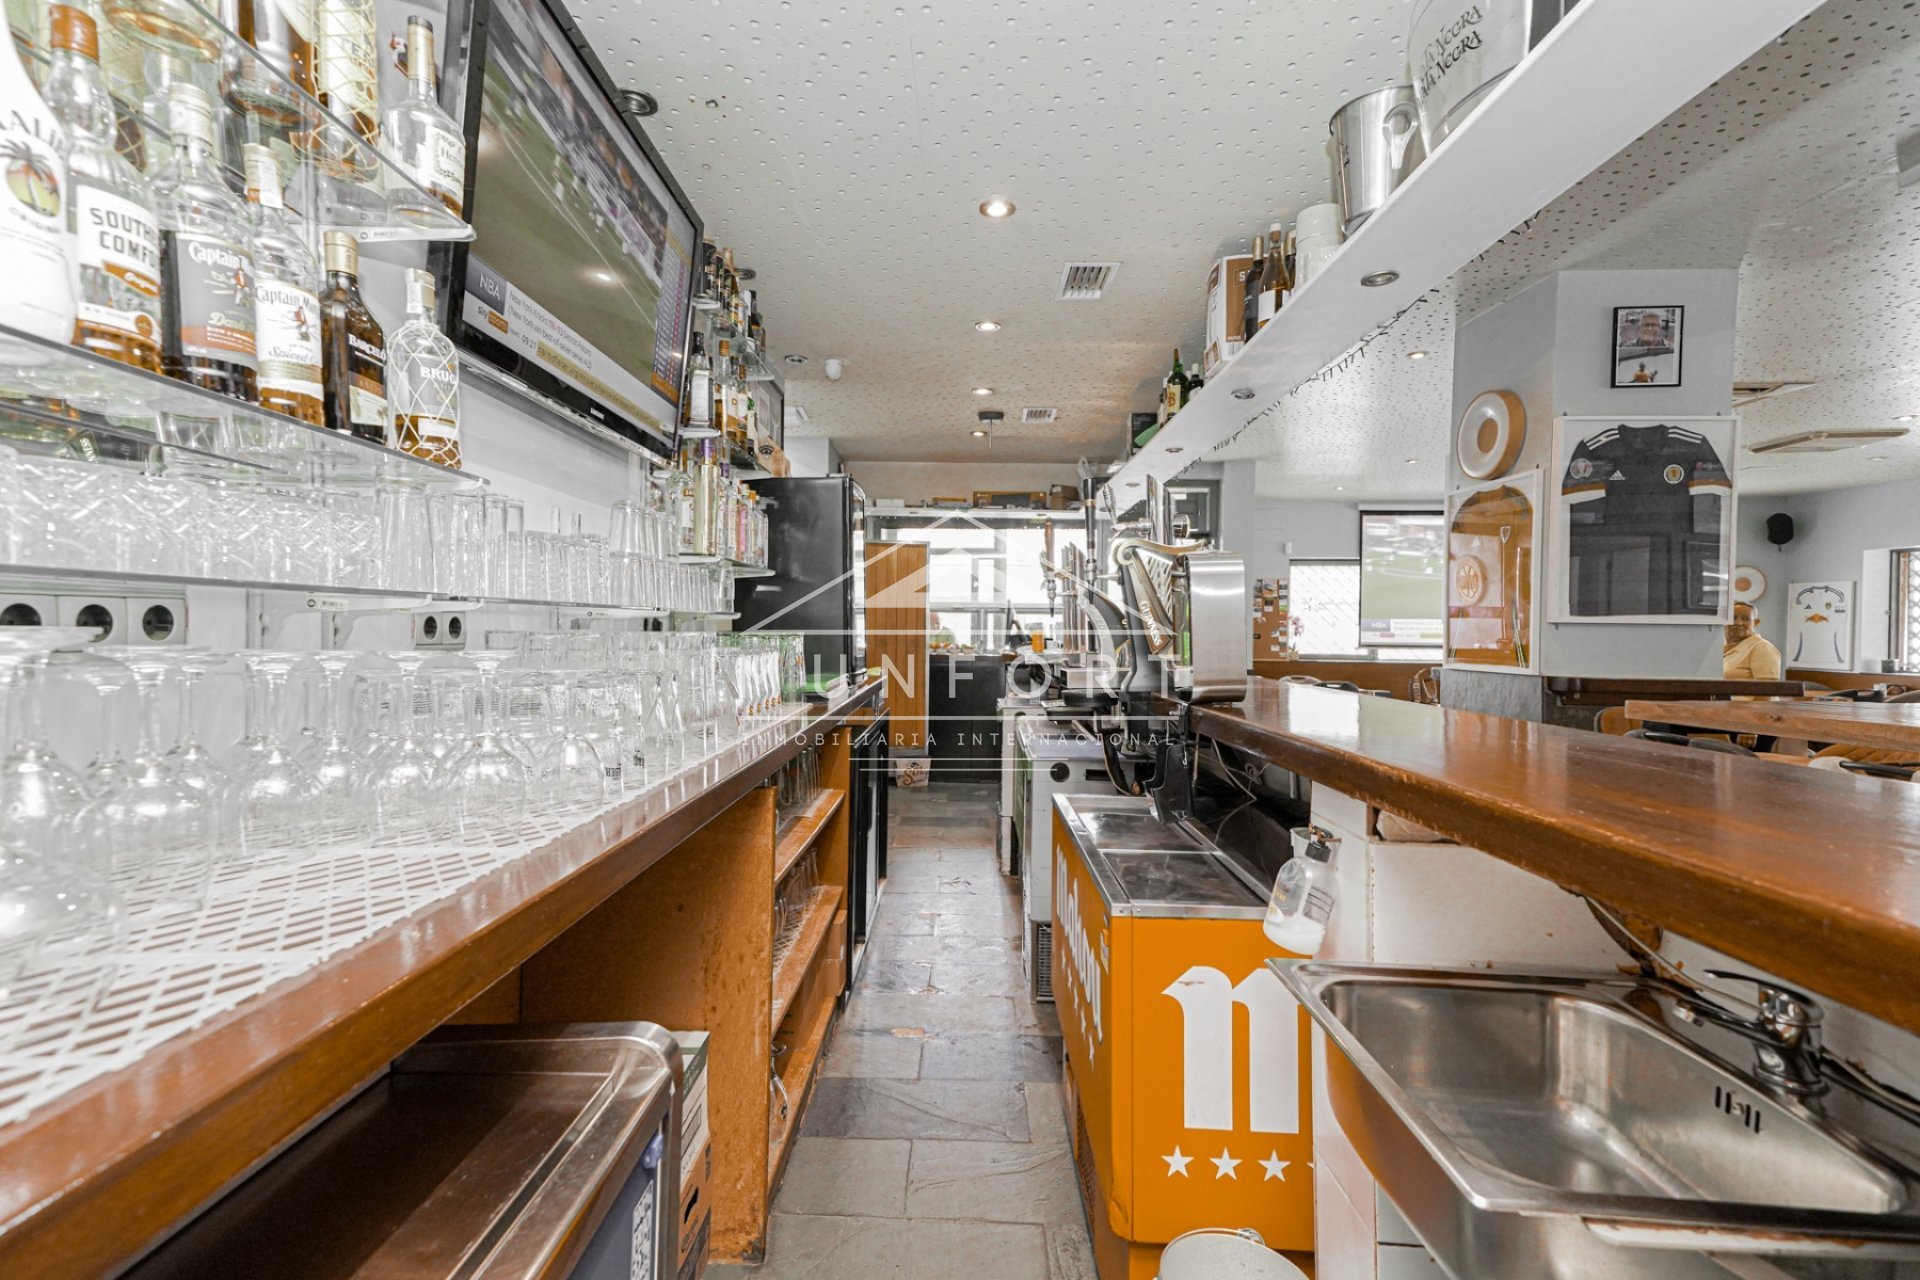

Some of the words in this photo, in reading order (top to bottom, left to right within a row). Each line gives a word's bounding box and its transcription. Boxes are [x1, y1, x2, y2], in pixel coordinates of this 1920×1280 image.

[1437, 30, 1483, 80] NEGRA
[188, 241, 239, 270] Captain
[255, 284, 300, 307] Captain
[479, 273, 500, 300] NBA
[267, 345, 308, 363] Spiced
